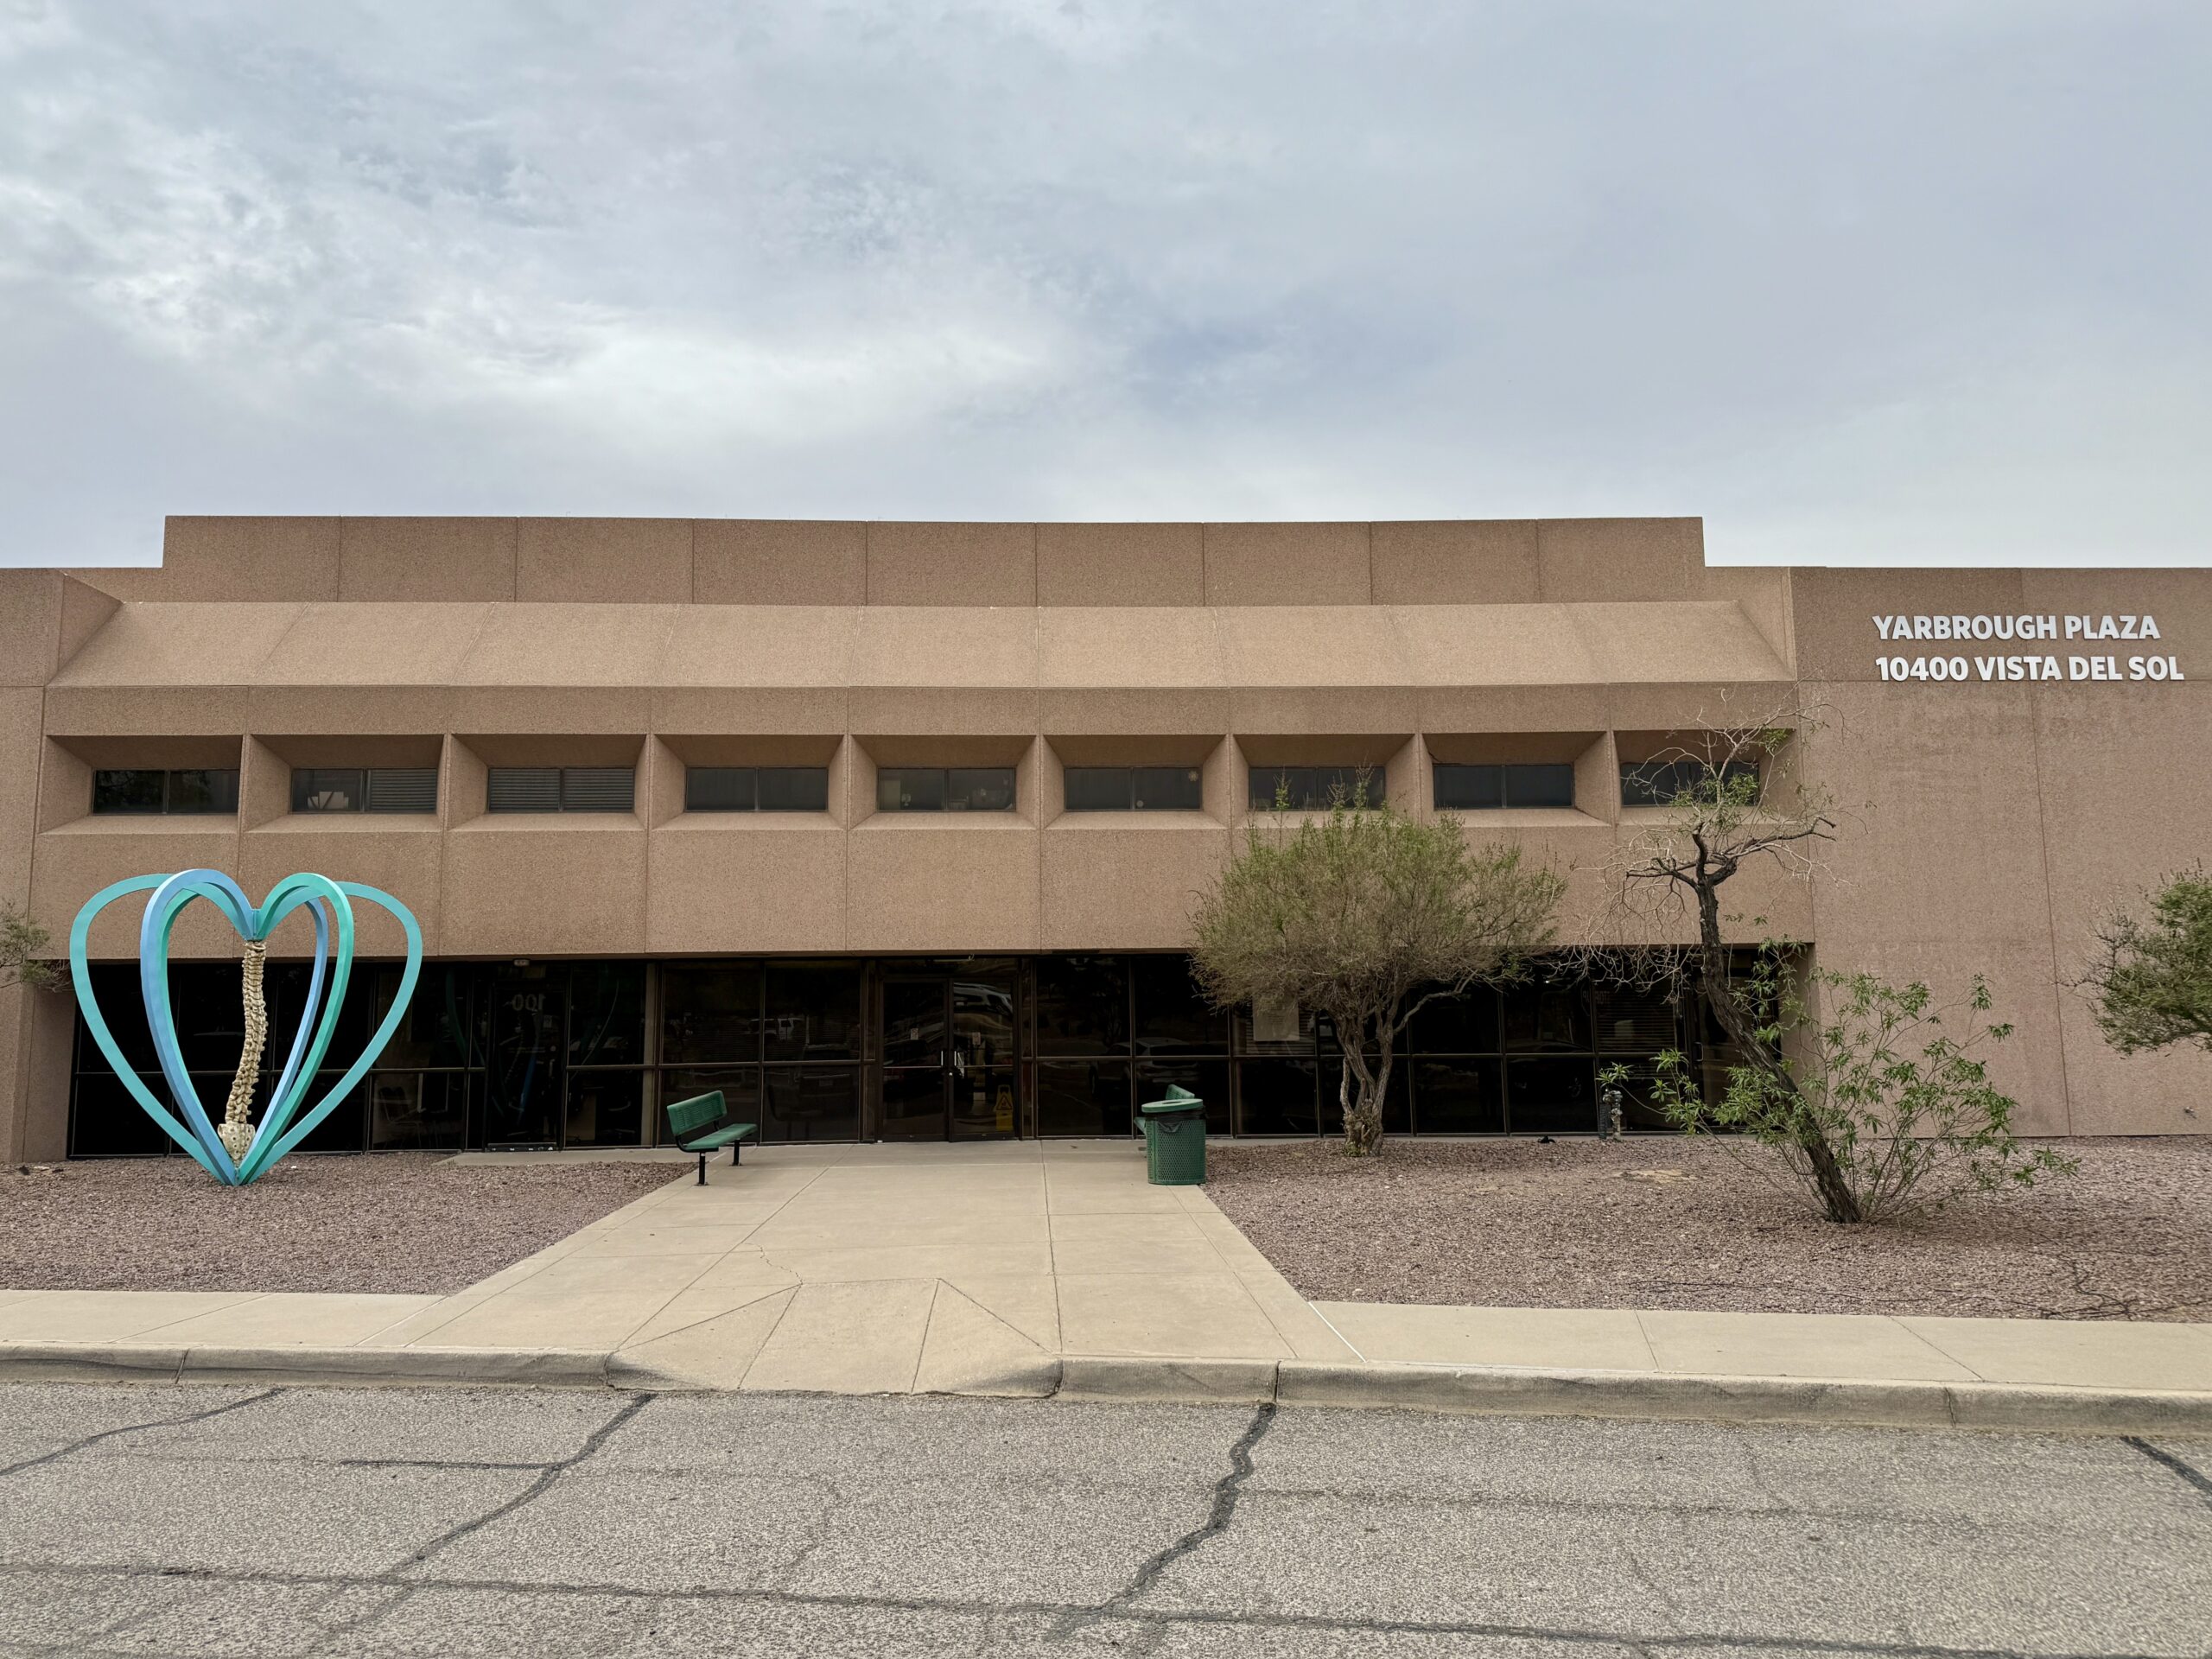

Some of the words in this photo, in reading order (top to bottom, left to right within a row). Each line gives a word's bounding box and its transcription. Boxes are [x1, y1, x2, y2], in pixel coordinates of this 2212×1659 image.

[1872, 615, 2057, 640] YARBROUGH
[2063, 614, 2162, 639] PLAZA
[1875, 657, 1969, 681] 10400
[1974, 656, 2063, 681] VISTA
[2068, 656, 2123, 681] DEL
[2128, 656, 2185, 681] SOL
